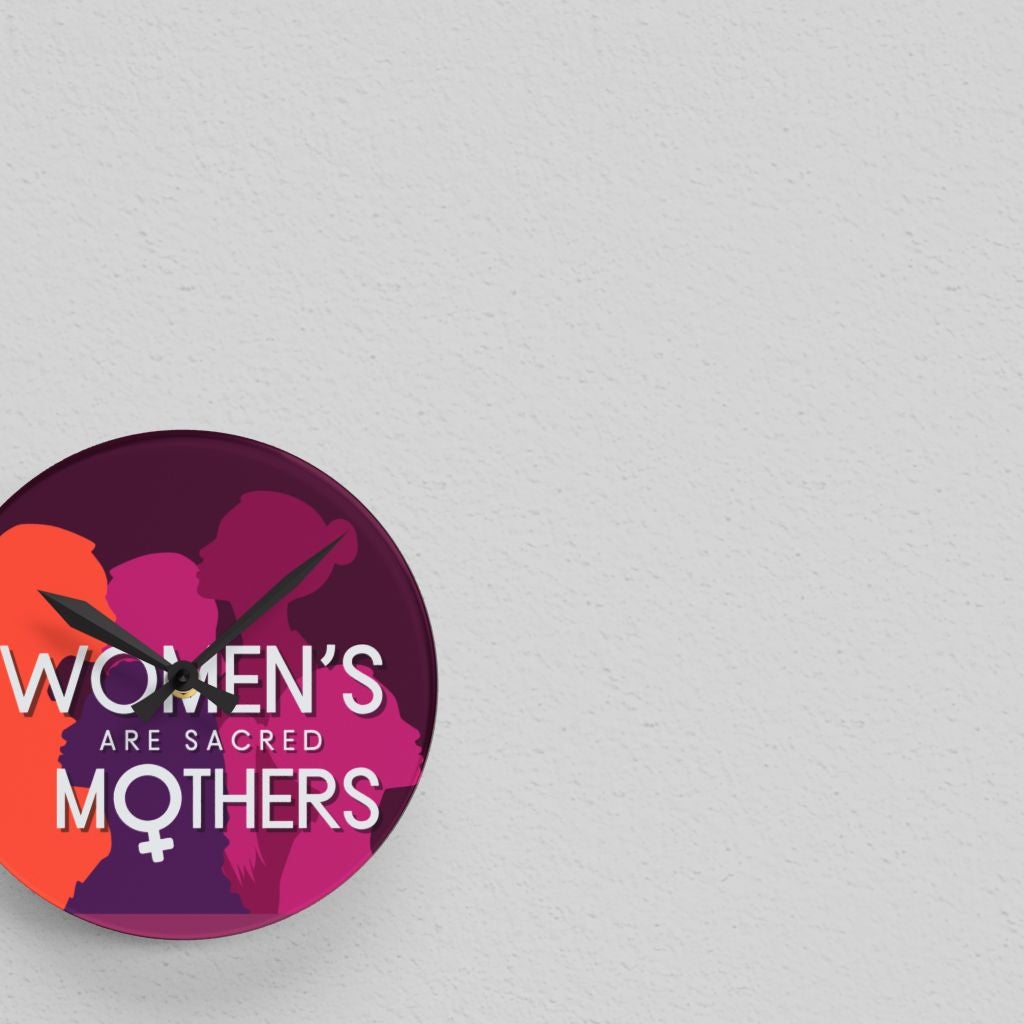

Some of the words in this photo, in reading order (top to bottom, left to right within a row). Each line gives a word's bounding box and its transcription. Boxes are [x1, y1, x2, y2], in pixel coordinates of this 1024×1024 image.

[0, 643, 384, 715] WOMEN'S
[99, 729, 161, 751] ARE
[185, 729, 324, 751] SACRED
[56, 763, 380, 863] MOTHERS
